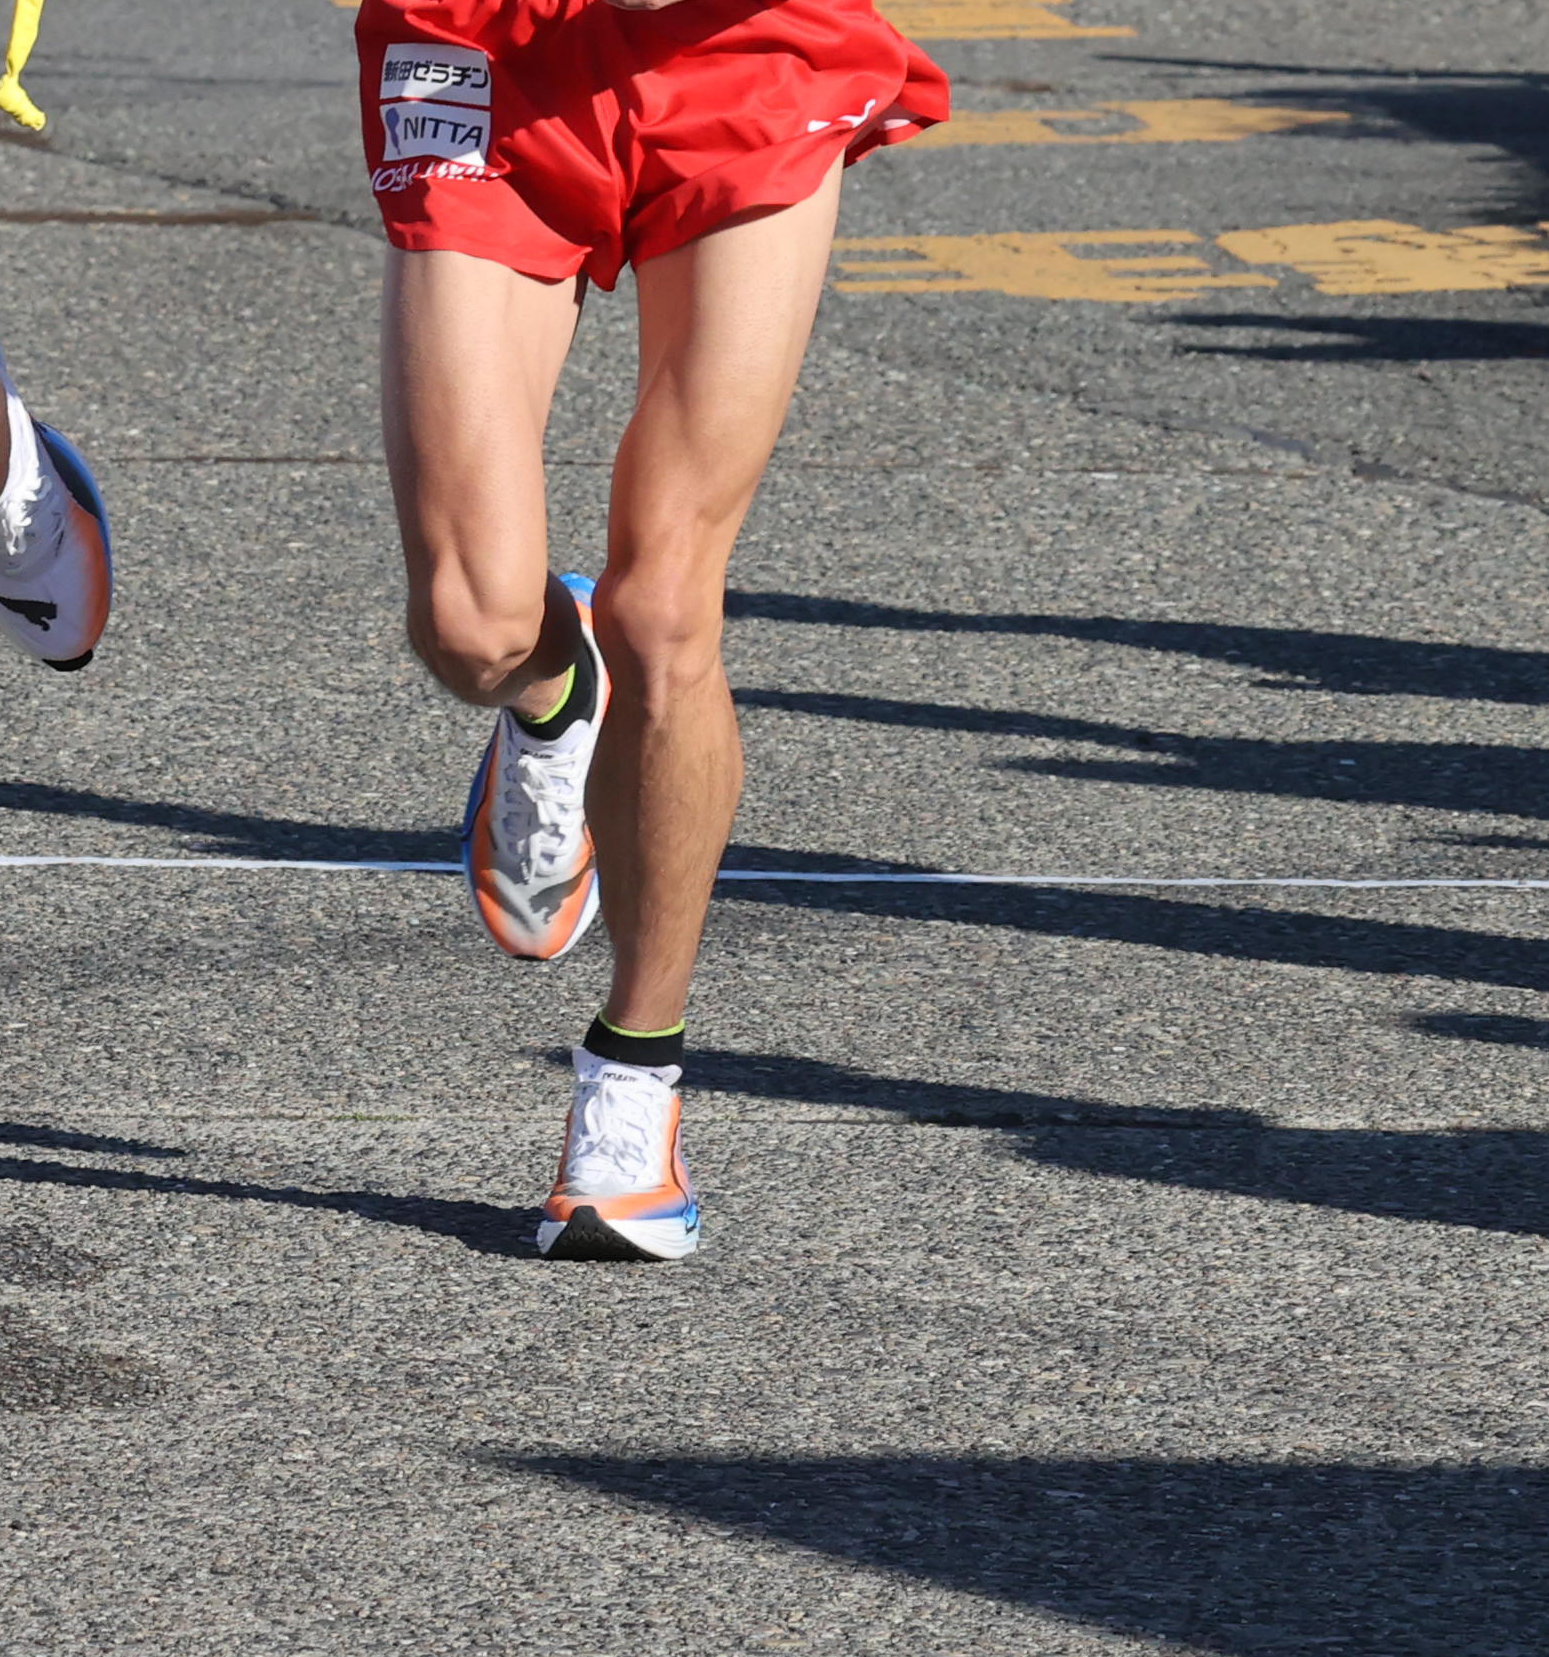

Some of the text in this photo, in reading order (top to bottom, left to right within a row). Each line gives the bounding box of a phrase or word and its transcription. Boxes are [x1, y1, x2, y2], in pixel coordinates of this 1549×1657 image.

[383, 60, 489, 89] 新田ゼラチン
[403, 116, 484, 149] NITTA
